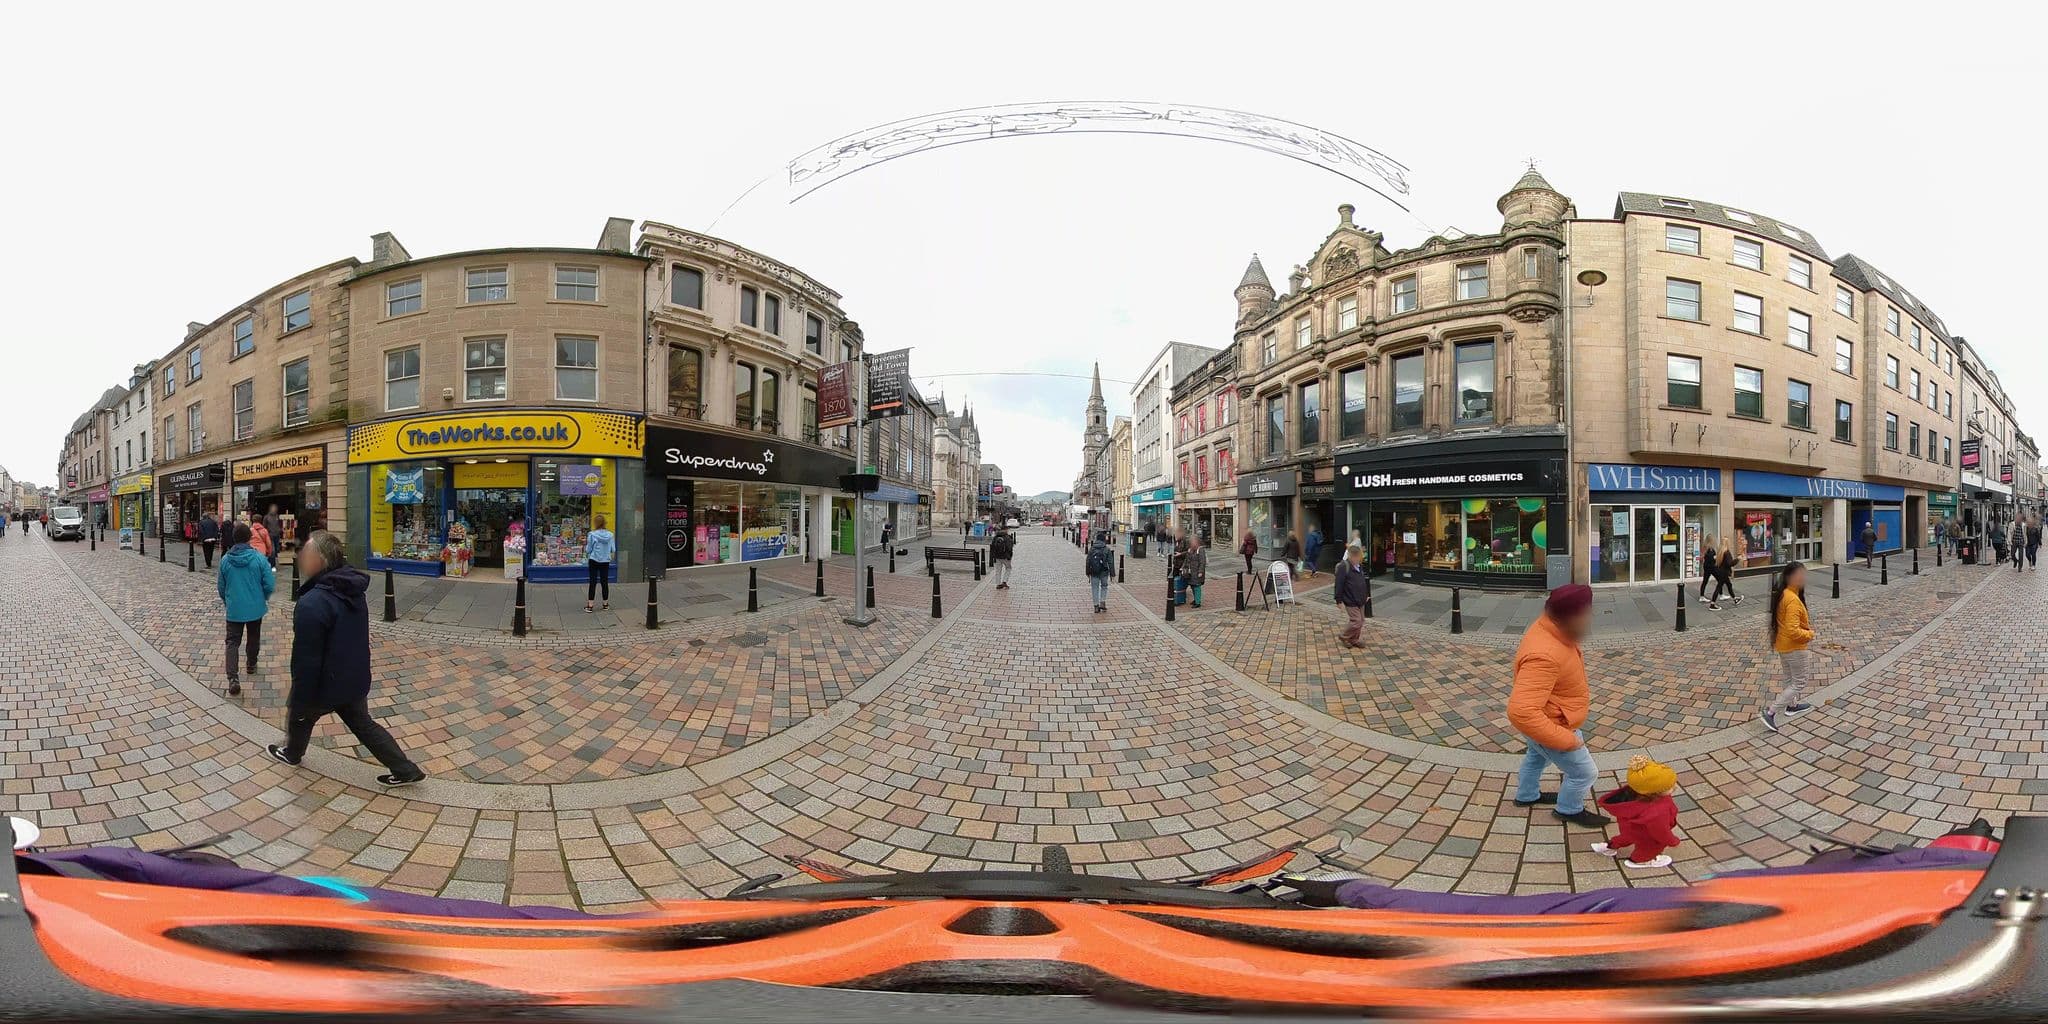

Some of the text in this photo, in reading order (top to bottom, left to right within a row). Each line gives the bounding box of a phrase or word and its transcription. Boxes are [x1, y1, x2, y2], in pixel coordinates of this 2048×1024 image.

[871, 353, 905, 365] Inverness
[870, 361, 907, 373] Old Town
[824, 399, 846, 413] 1870
[406, 422, 568, 447] TheWorks.co.uk
[241, 456, 309, 475] THE HIGHLANDER
[665, 448, 767, 475] Superdrug
[170, 471, 204, 483] GLENEAGLES
[1354, 473, 1523, 488] LUSH FRESH HANDMADE COSMETICS
[1595, 465, 1715, 491] WHSmith
[1249, 481, 1279, 493] LOS BURRITO
[1807, 478, 1868, 498] WHSmith
[668, 511, 688, 519] save
[667, 518, 688, 526] more
[768, 533, 788, 546] £20
